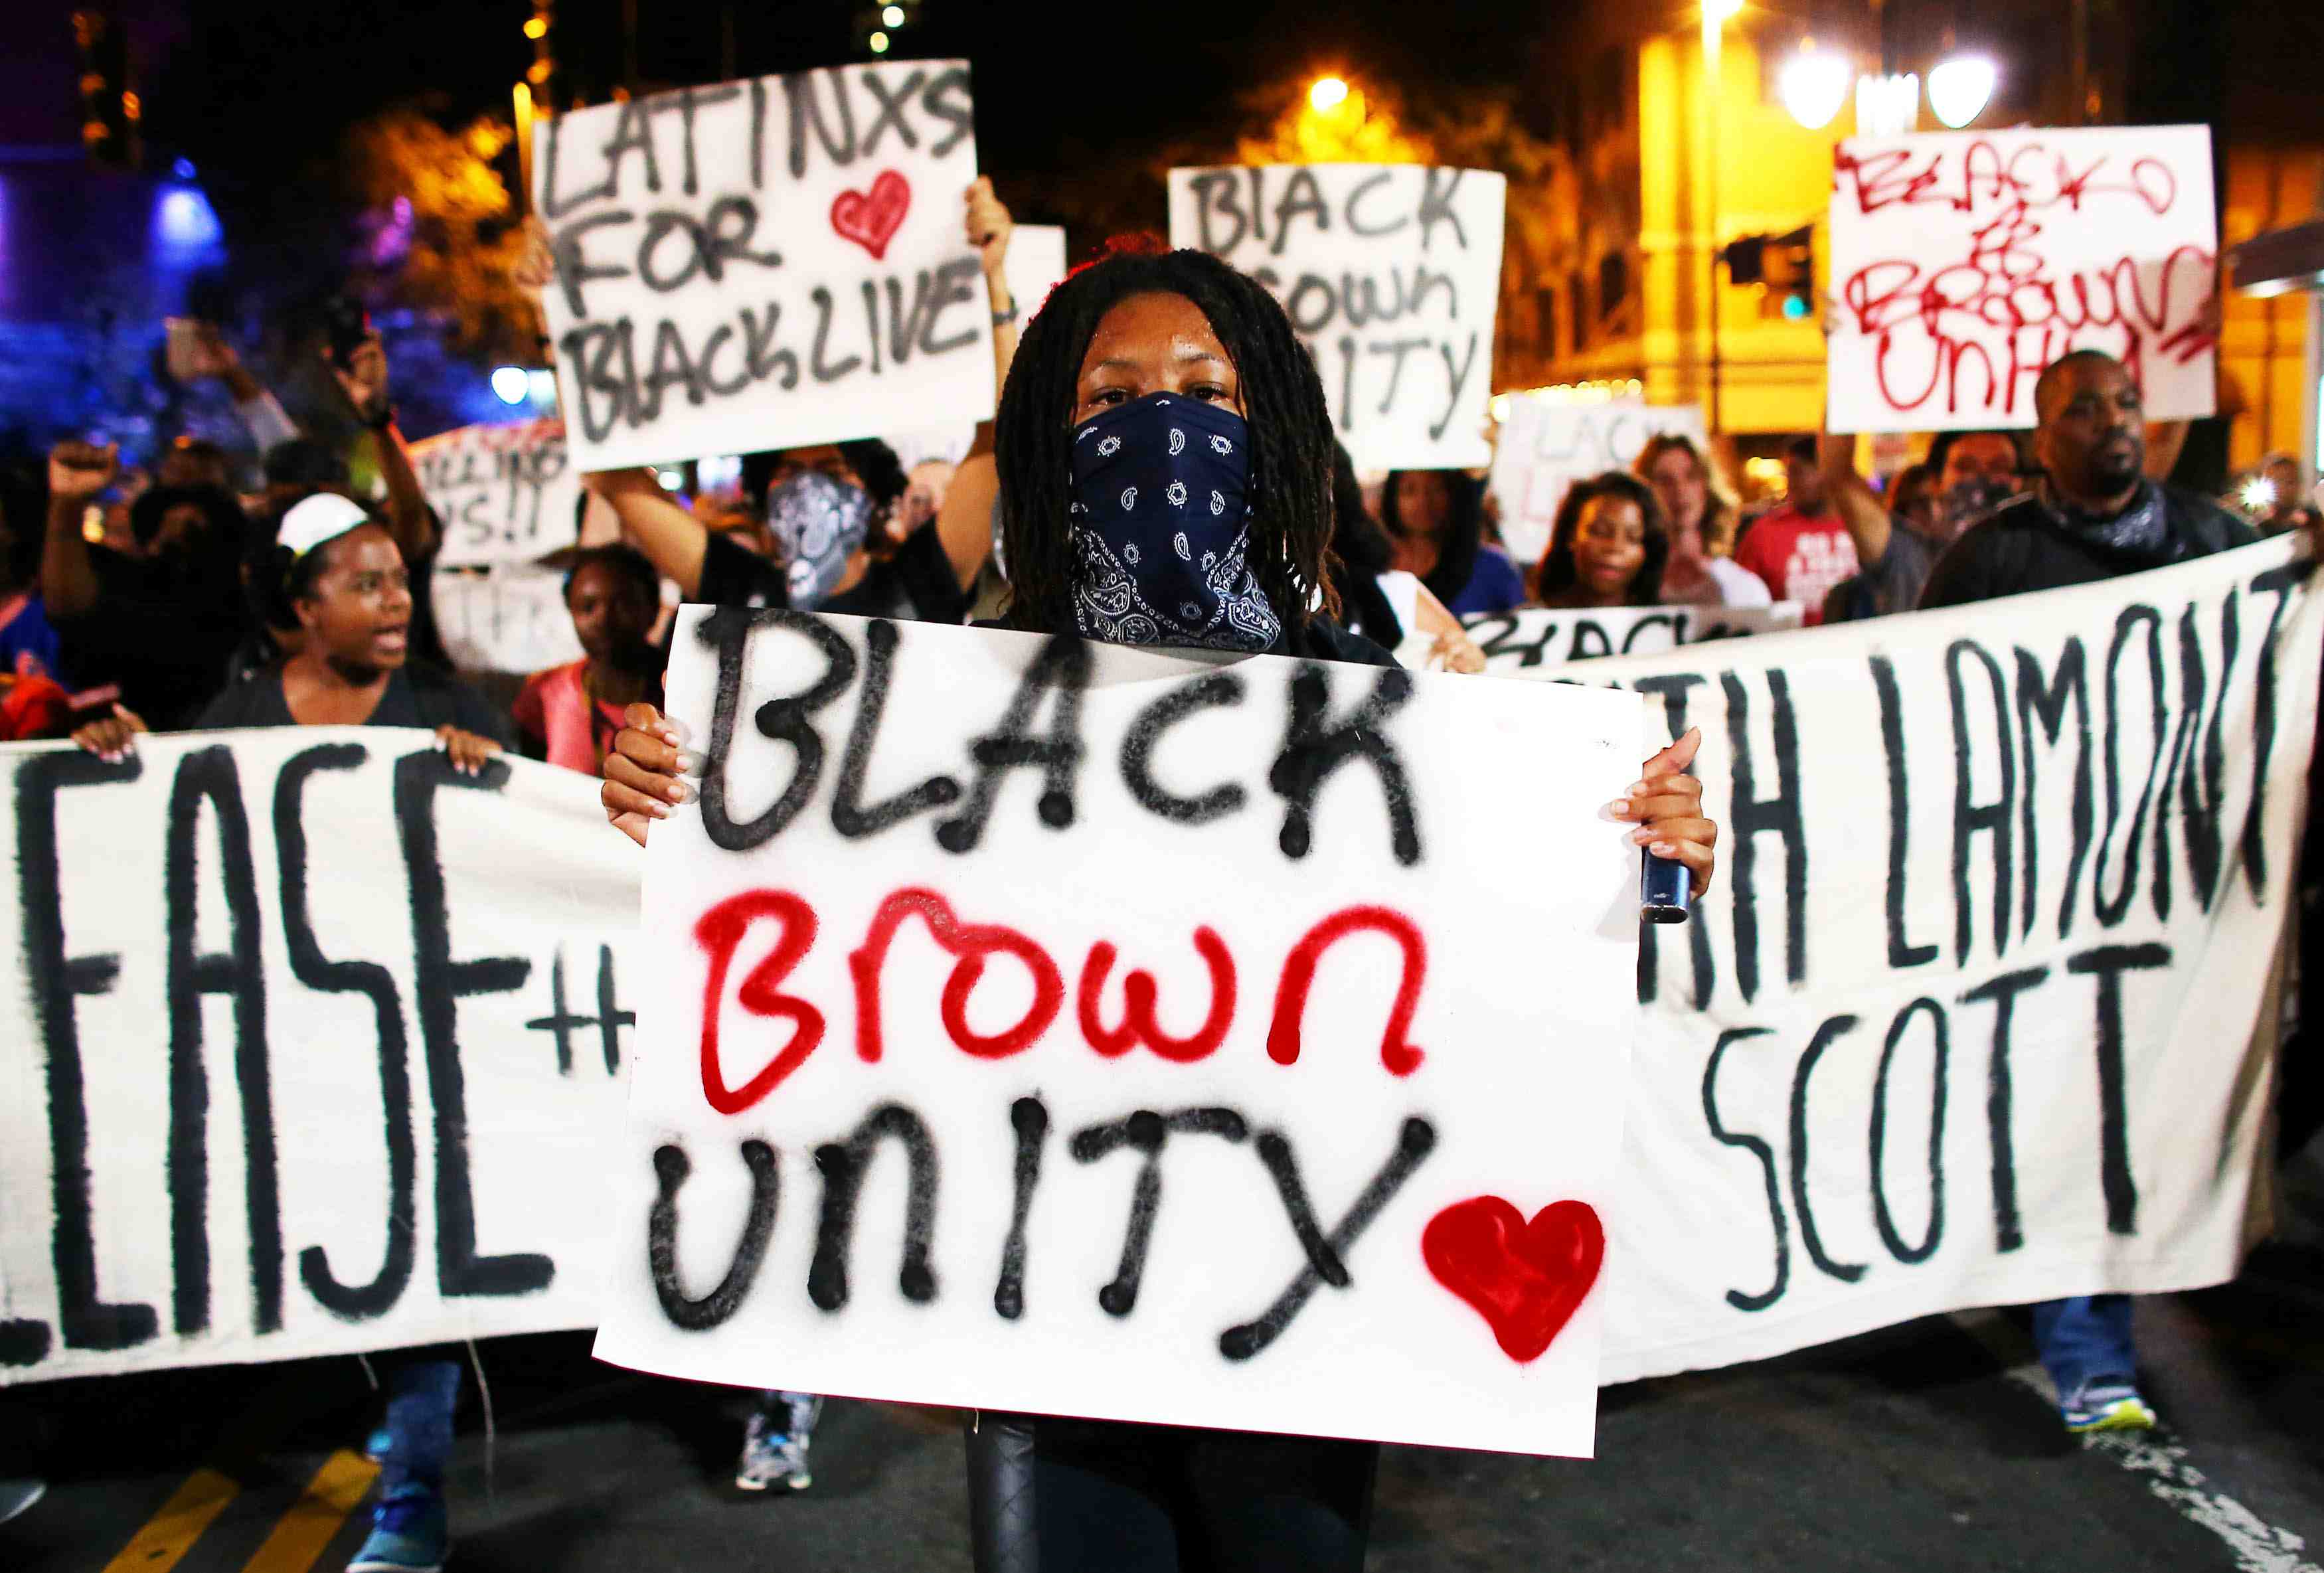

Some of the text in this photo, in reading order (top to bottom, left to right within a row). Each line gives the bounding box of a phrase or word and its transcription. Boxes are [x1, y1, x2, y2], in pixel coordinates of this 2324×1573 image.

[544, 68, 973, 218] LATINXS
[552, 195, 782, 319] FOR
[560, 255, 983, 444] BLACK LIVE
[1307, 331, 1478, 442] ITY
[695, 606, 1424, 865] BLACK
[1867, 559, 2317, 971] LAMONT
[0, 742, 556, 1368] EASE
[693, 886, 1428, 1117] Brown
[647, 1092, 1438, 1363] UNITY
[1701, 941, 2174, 1313] SCOTT
